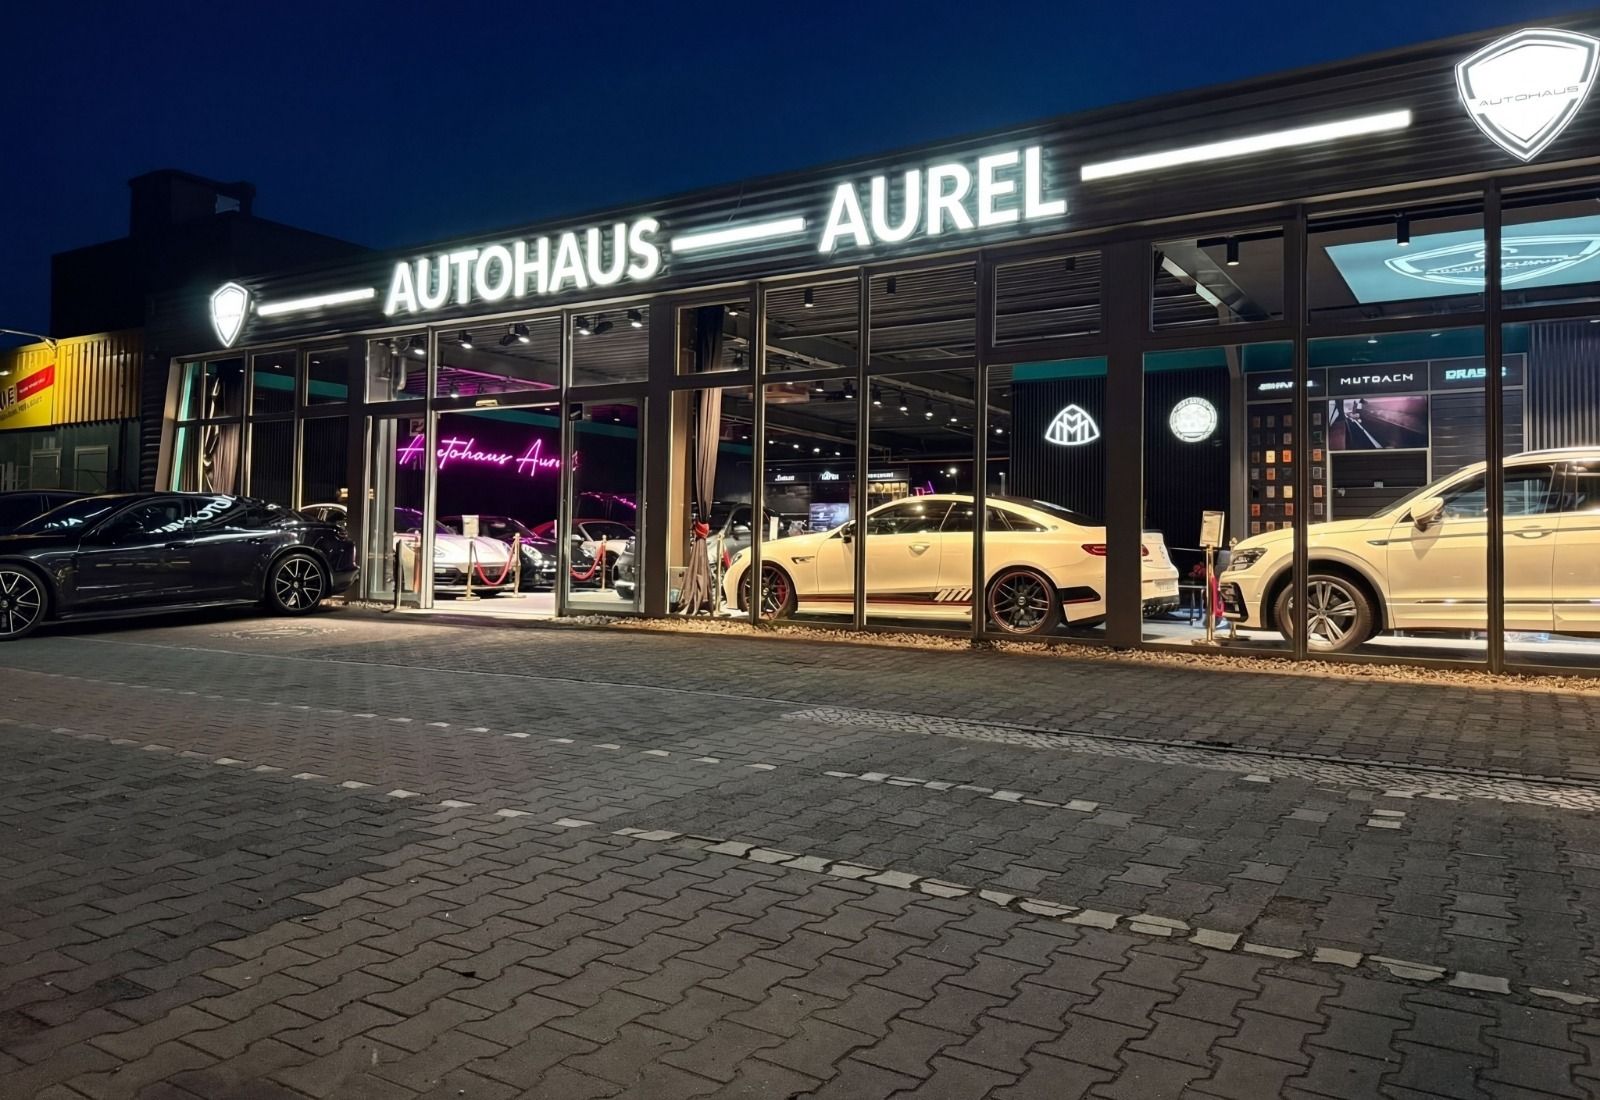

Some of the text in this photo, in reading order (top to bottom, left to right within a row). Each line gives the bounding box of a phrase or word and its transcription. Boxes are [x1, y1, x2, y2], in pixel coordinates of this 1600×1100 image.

[1479, 85, 1579, 106] AUTOHAUS
[384, 146, 1068, 317] AUTOHAUS AUREL
[397, 434, 513, 470] Atohaus
